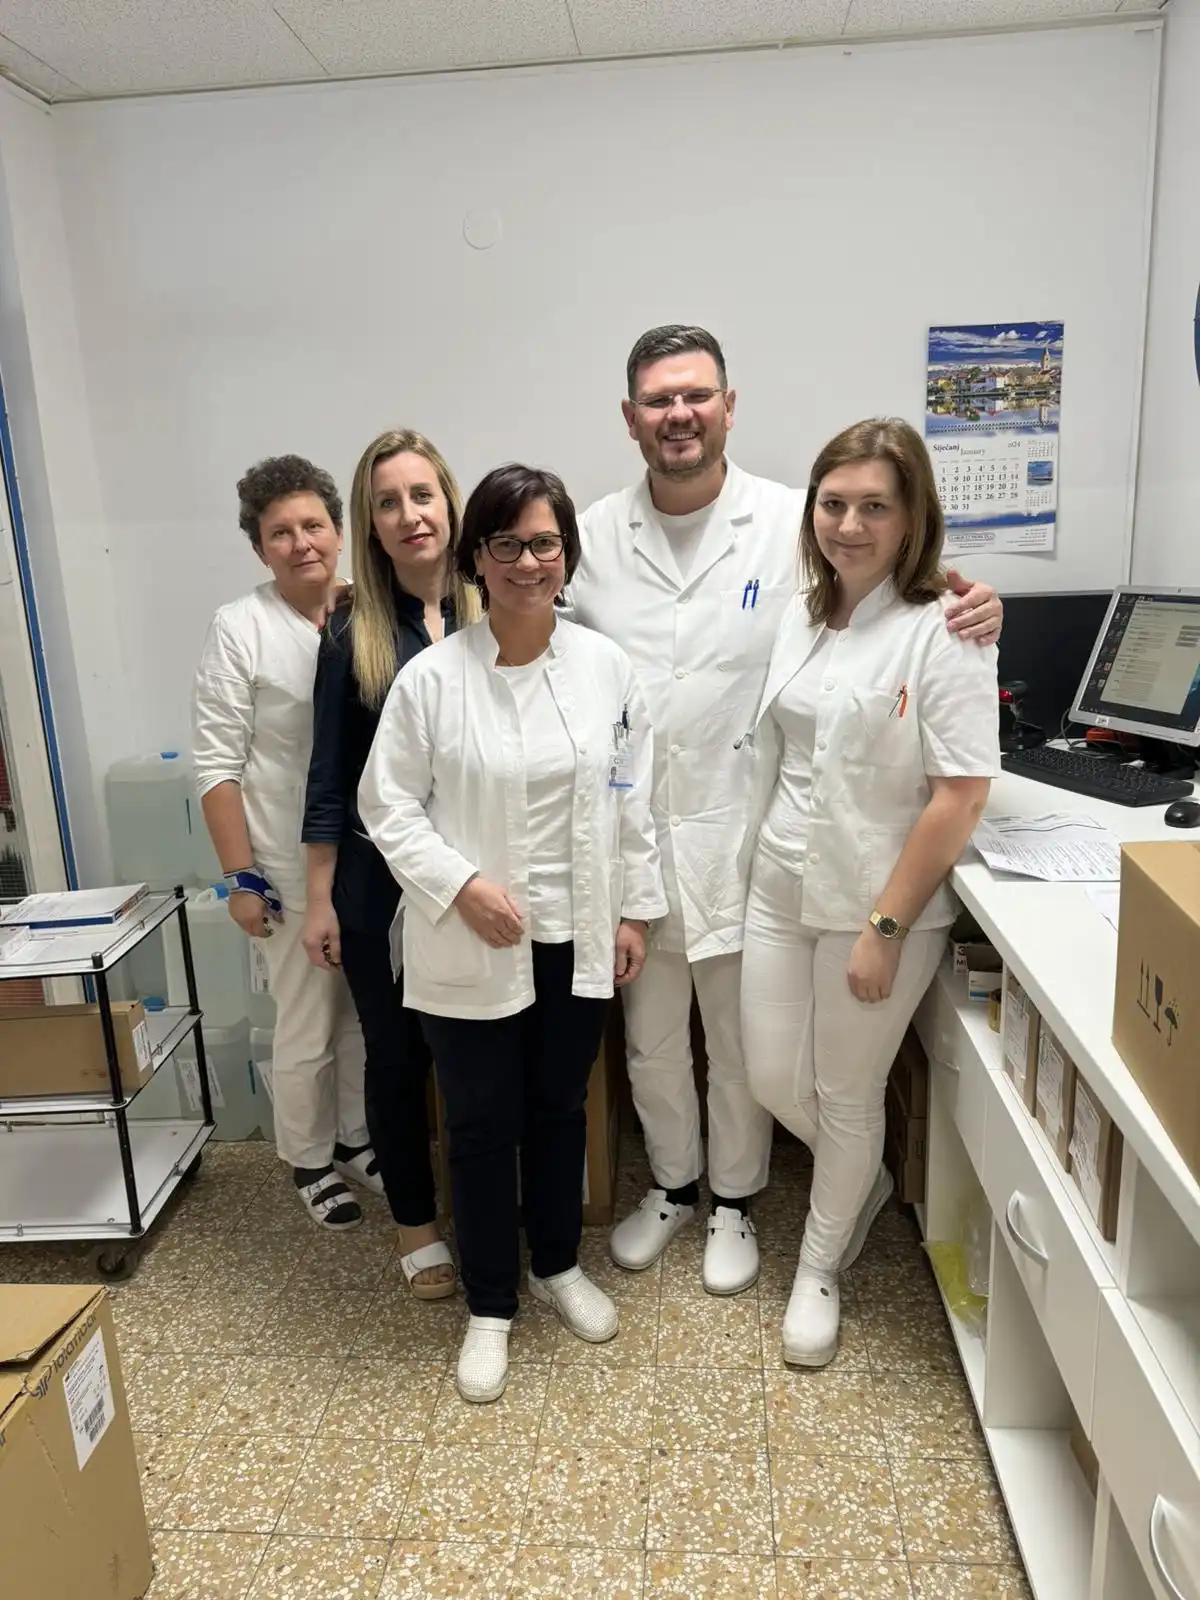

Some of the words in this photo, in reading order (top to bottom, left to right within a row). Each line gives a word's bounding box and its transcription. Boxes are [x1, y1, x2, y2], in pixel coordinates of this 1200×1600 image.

[974, 474, 982, 482] 11
[999, 473, 1007, 481] 13
[951, 485, 959, 493] 16
[962, 484, 970, 492] 17
[974, 483, 983, 491] 18
[986, 482, 995, 490] 19
[998, 482, 1007, 490] 20
